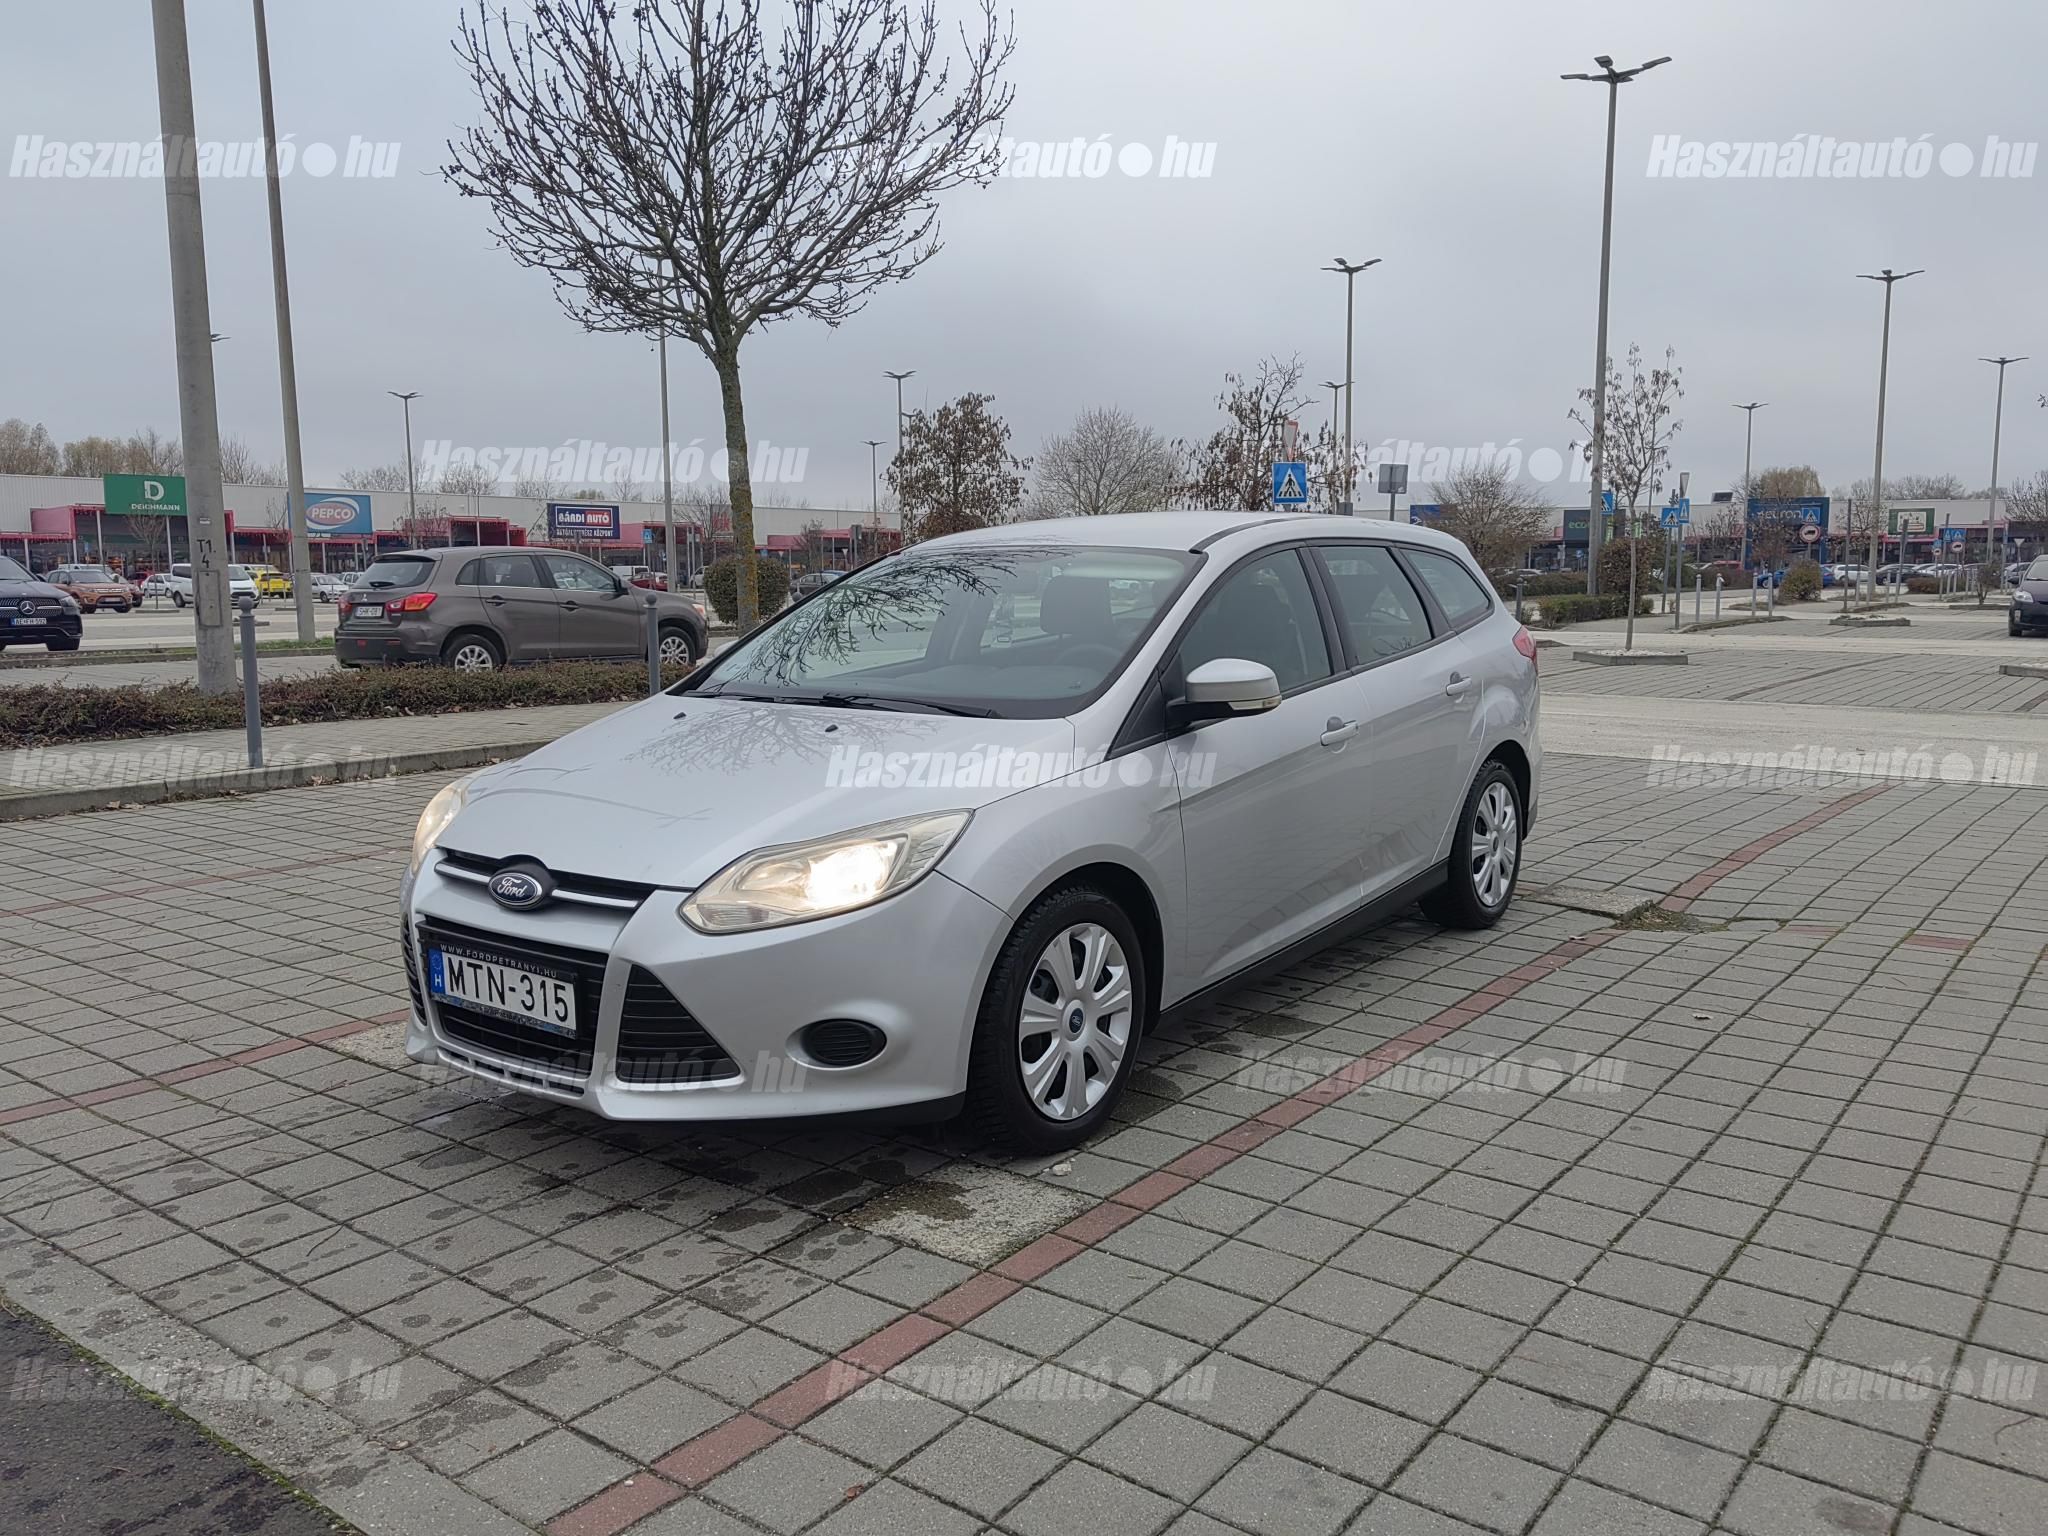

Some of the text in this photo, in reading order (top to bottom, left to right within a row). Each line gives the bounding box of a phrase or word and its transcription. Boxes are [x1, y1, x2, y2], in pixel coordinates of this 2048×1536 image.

[131, 503, 180, 511] DEICHMANN
[311, 508, 351, 519] PEPCO
[496, 876, 526, 898] Ford
[440, 943, 557, 978] WWW.FORDPETRANYI.HU
[447, 956, 569, 1023] MTN-315
